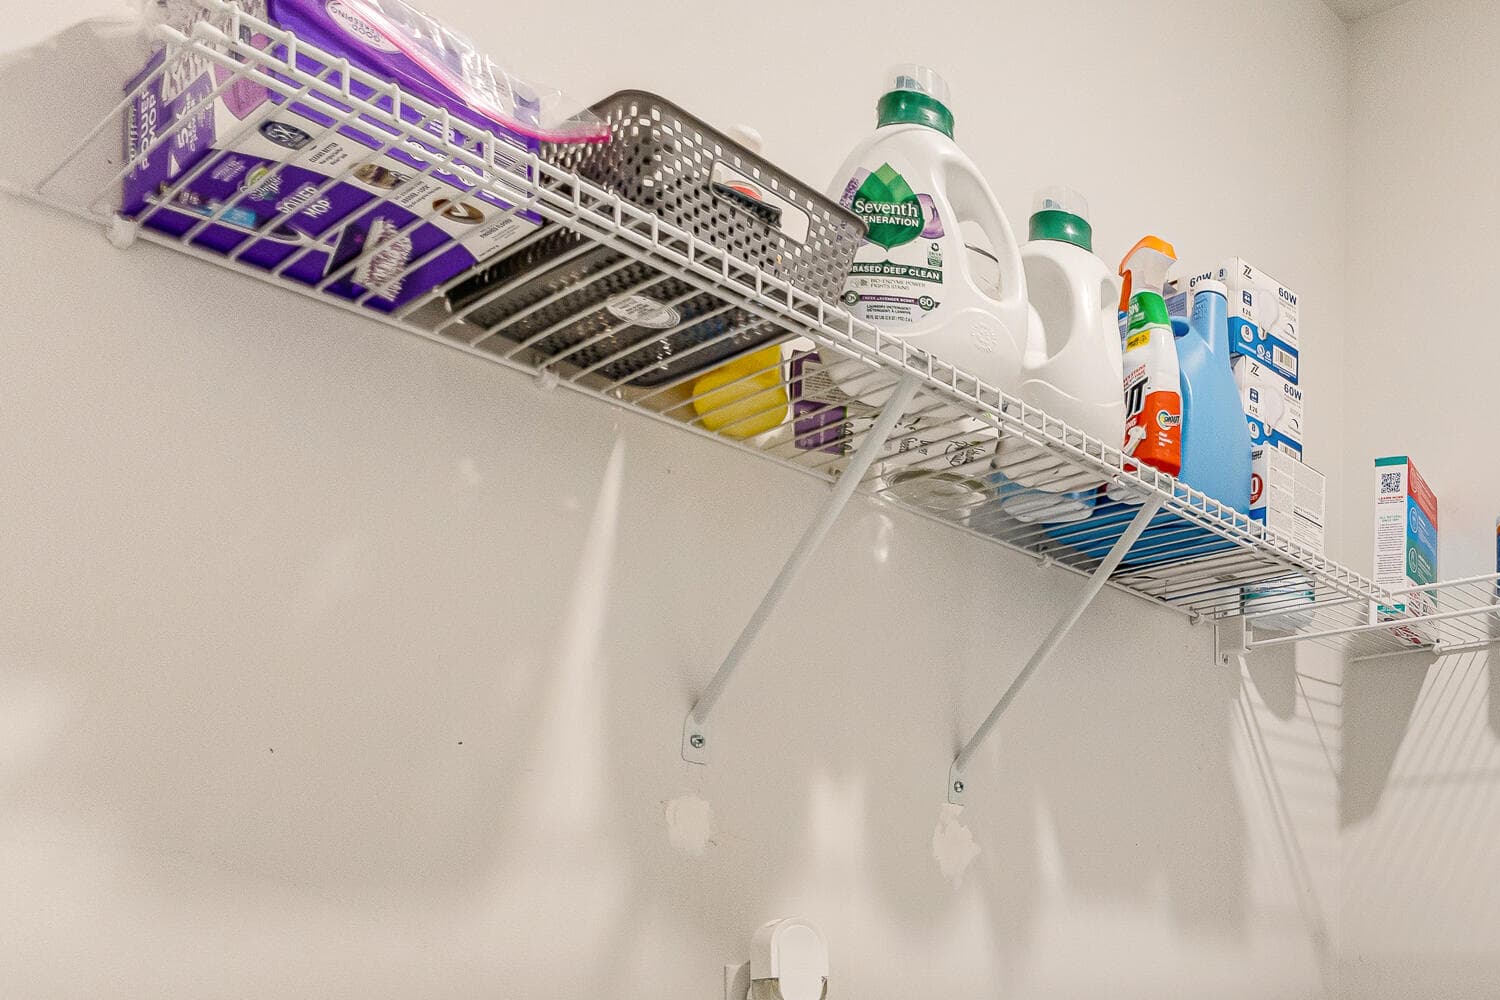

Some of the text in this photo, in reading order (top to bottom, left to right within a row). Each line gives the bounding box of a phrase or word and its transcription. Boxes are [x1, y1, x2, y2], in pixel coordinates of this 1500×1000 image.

[303, 197, 331, 218] MOP
[855, 200, 919, 218] Seventh
[850, 265, 940, 280] BASED DEEP CLEAN
[920, 298, 932, 307] 60
[1279, 287, 1297, 306] 60W
[1284, 383, 1302, 401] 60W
